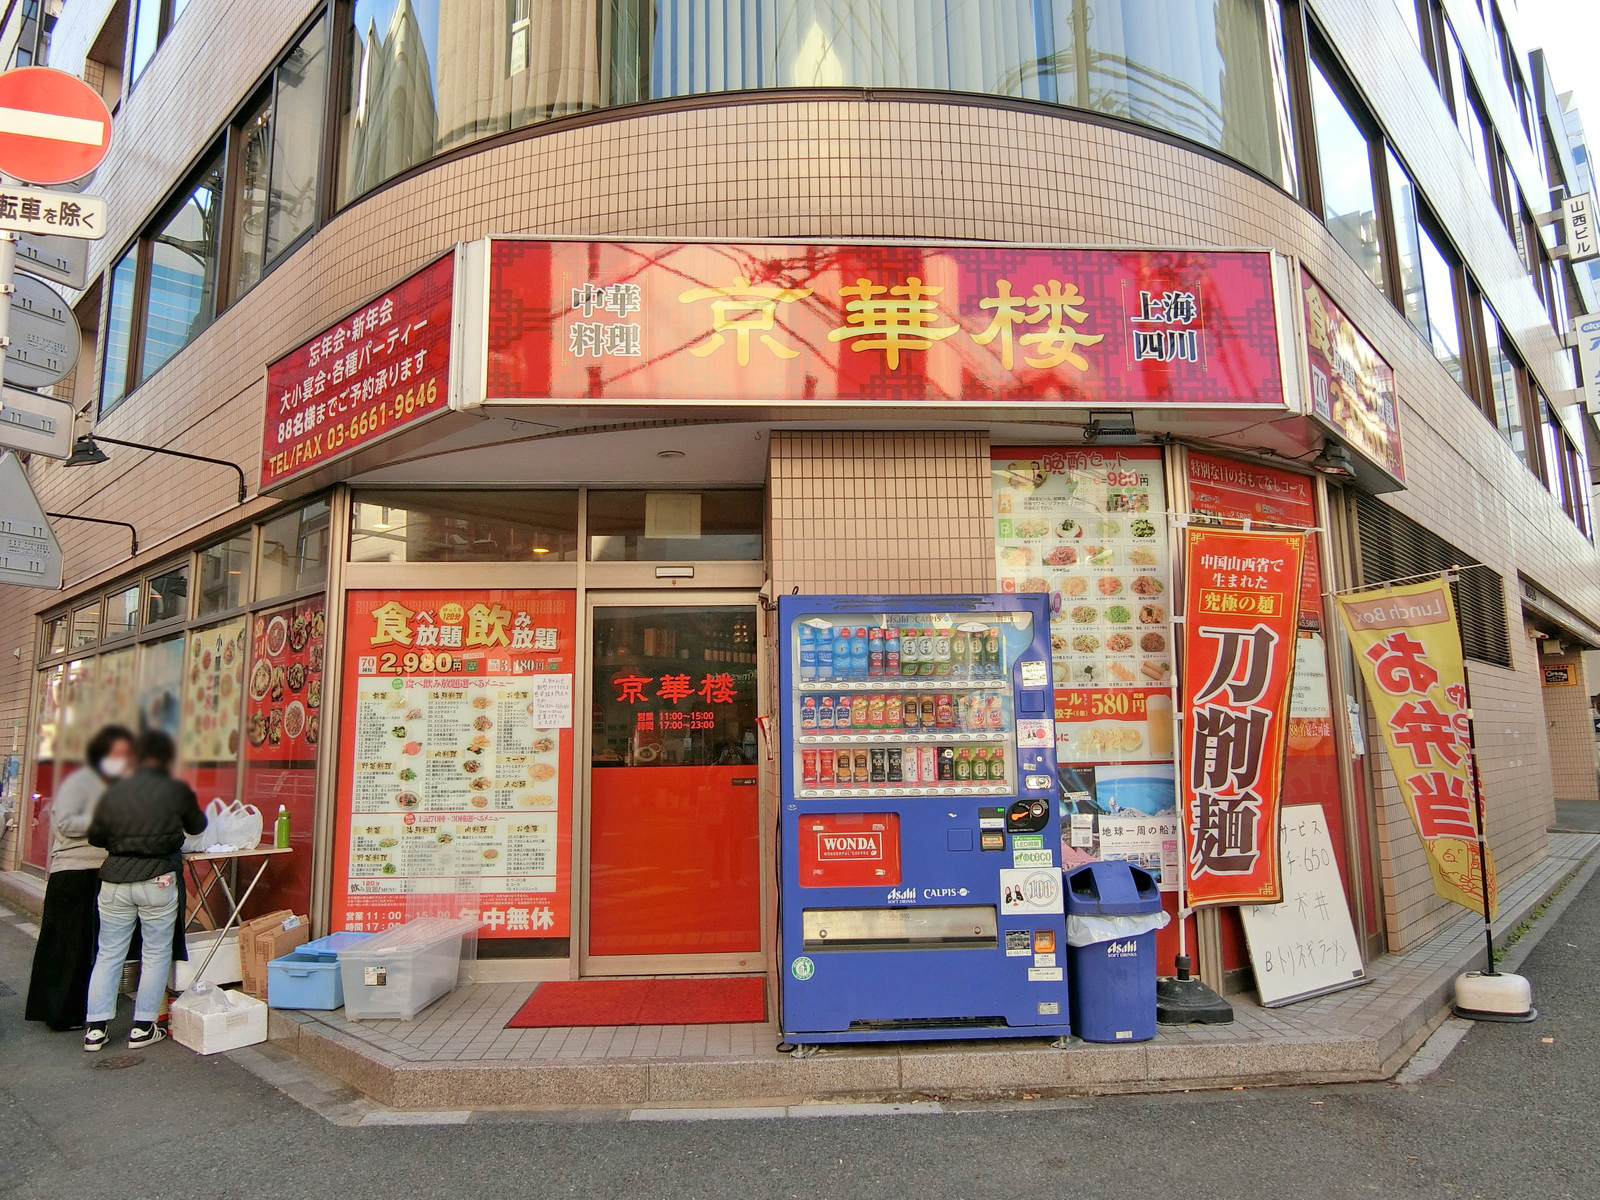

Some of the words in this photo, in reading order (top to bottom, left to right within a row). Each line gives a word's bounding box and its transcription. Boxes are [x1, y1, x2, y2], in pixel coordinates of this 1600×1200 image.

[1570, 200, 1591, 255] 山西ビル
[571, 283, 641, 317] 中華
[1131, 290, 1196, 325] 上海
[308, 298, 394, 367] 忘年会・新年会
[678, 276, 1105, 372] 京華楼
[569, 322, 642, 358] 料理
[1132, 328, 1199, 363] 四川
[280, 319, 428, 415] 大小宴会・各種パーティー
[277, 349, 428, 444] 88名様までご予約承ります
[1312, 370, 1329, 404] 70
[269, 433, 323, 477] TEL/FAX
[327, 377, 438, 451] 03-6661-9646
[1043, 451, 1129, 475] 晩酌セット
[1190, 459, 1306, 498] 特別な日のおもてなしコース
[1200, 554, 1284, 573] 中国山西省で
[1211, 573, 1268, 590] 生まれた
[1204, 592, 1274, 614] 究極の麺
[370, 600, 464, 648] 食べ放題
[465, 603, 558, 651] 飲み放題
[361, 658, 375, 667] 70
[379, 652, 463, 676] 2,980円
[614, 673, 738, 705] 京華楼
[637, 712, 654, 722] 営業
[659, 712, 714, 721] 11:00～15:00
[637, 722, 654, 731] 時間
[659, 721, 715, 730] 17:00～23:00
[1190, 622, 1280, 877] 刀削麺
[824, 838, 877, 851] WONDA
[887, 887, 917, 900] Asahi
[924, 888, 957, 899] CALPIS
[345, 922, 363, 932] 時間
[346, 912, 364, 921] 営業
[458, 906, 555, 931] 年中無休
[1107, 940, 1137, 954] Asahi
[1266, 951, 1274, 973] B
